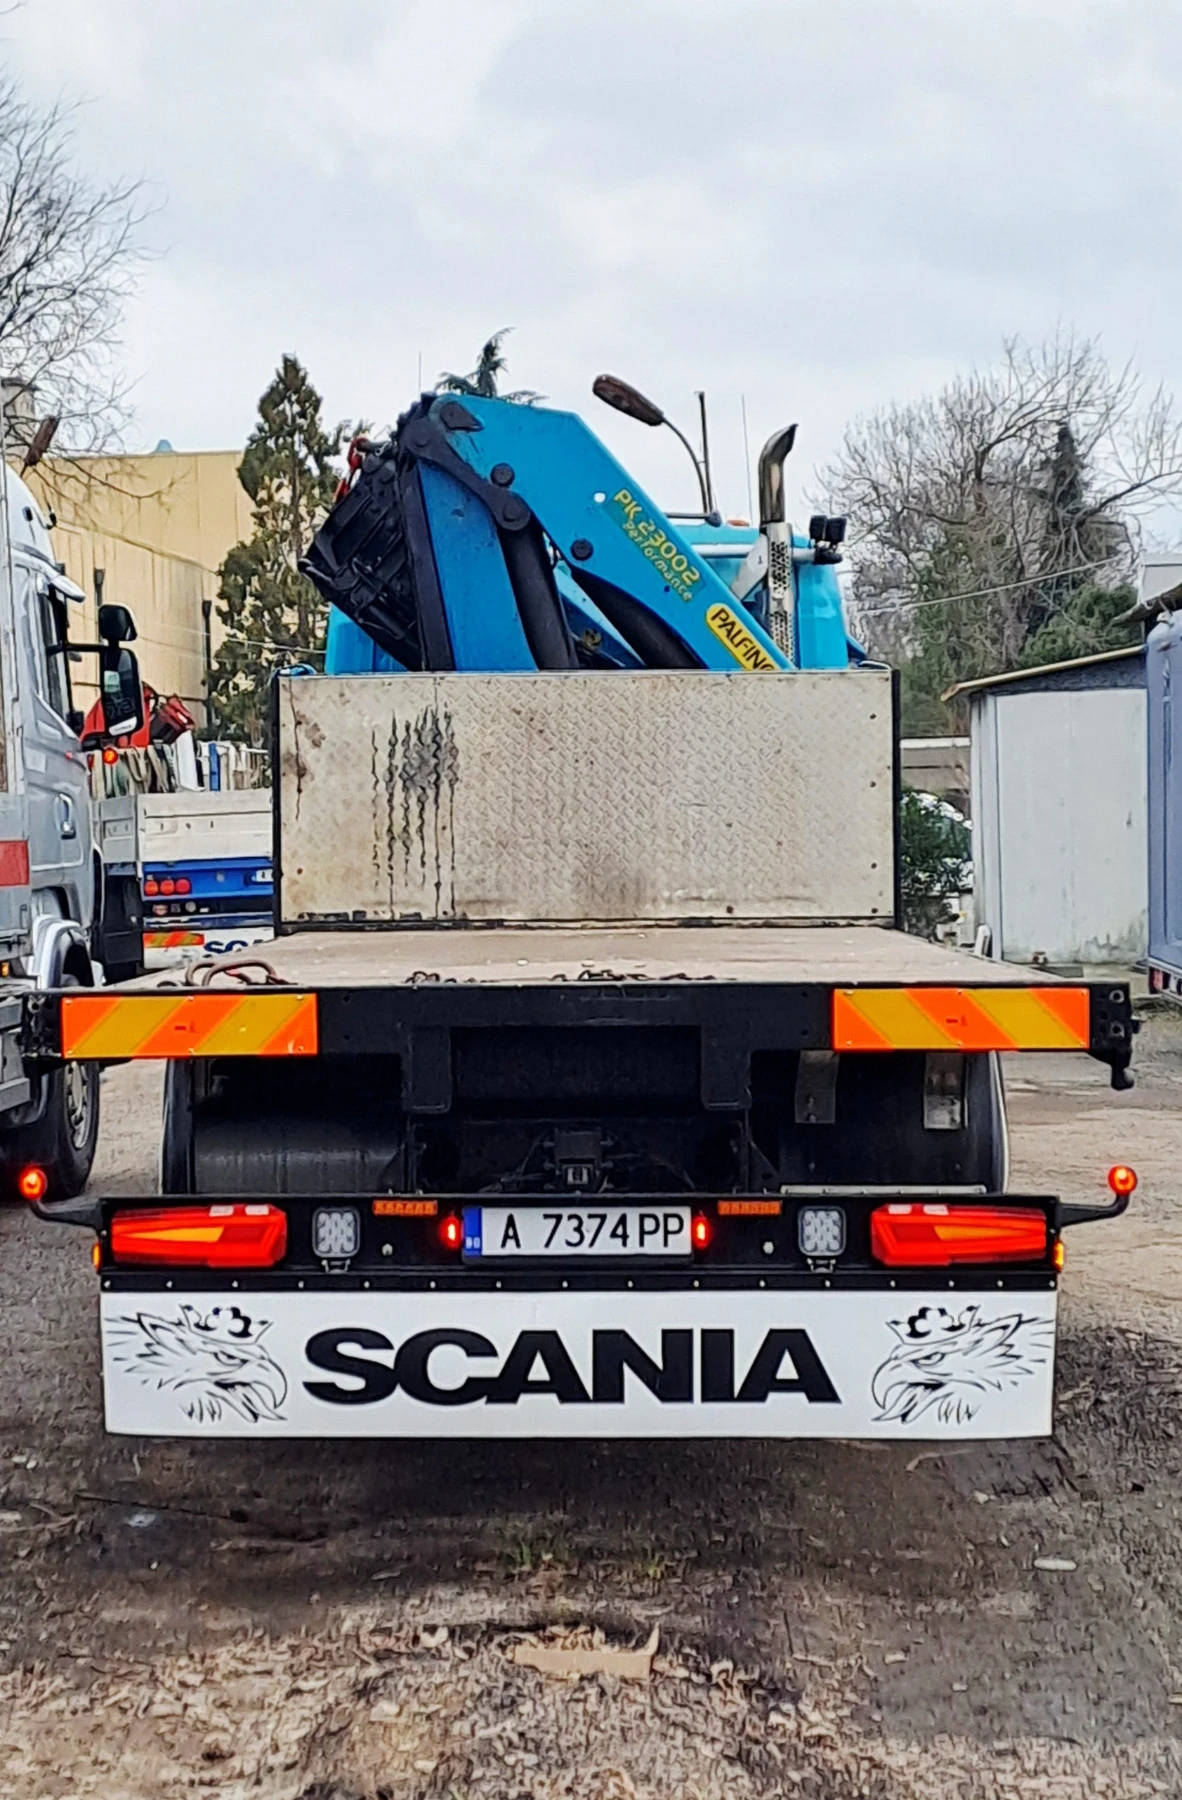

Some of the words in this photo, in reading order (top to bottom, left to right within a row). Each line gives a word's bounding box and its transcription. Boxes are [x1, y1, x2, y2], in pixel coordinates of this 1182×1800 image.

[614, 489, 642, 520] PK
[638, 521, 700, 586] 23002
[501, 1213, 522, 1249] A
[543, 1213, 629, 1249] 7374
[639, 1213, 685, 1248] PP
[302, 1327, 842, 1405] SCANIA
